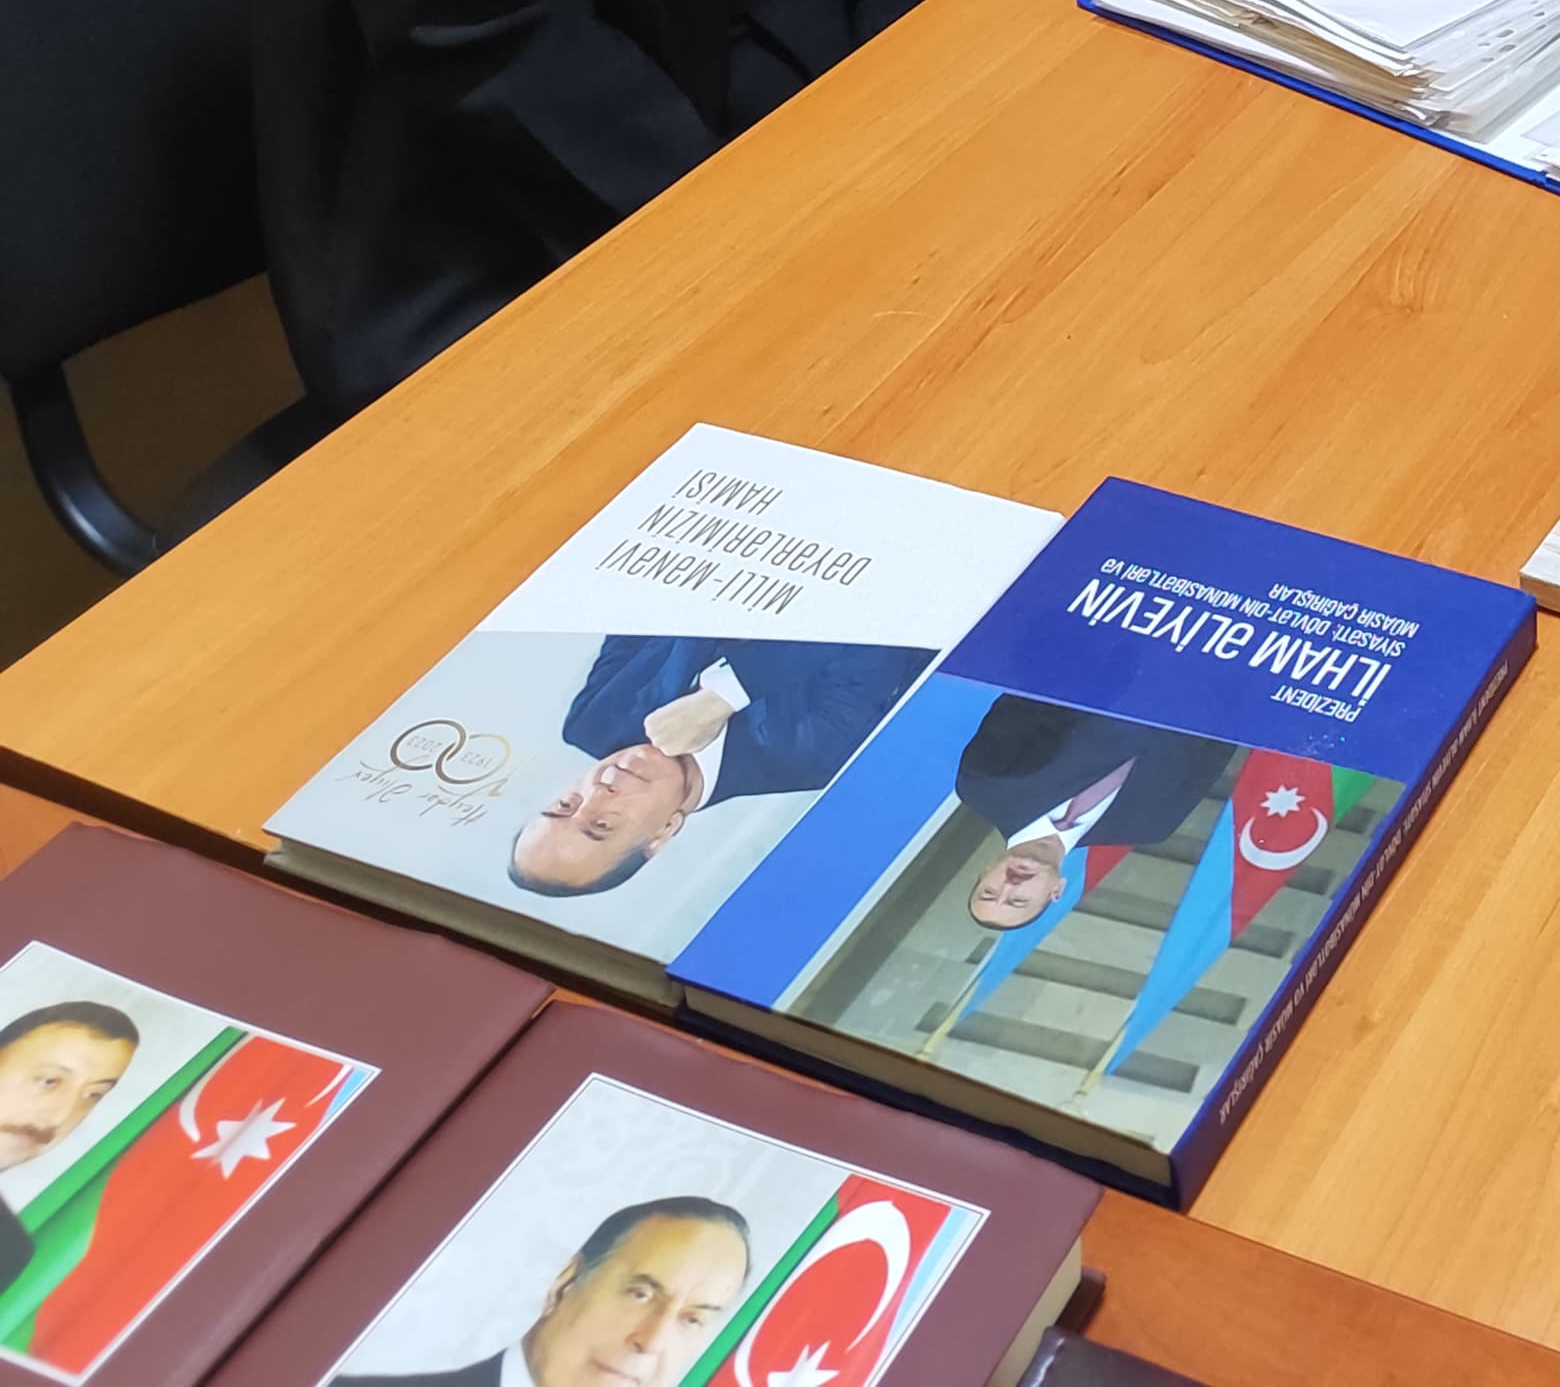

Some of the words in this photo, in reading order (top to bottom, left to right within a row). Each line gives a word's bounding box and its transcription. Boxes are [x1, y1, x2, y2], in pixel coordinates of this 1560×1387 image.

[672, 470, 783, 515] HAMİSİ
[638, 504, 872, 586] DƏYƏRLƏRİMİZİN
[595, 542, 804, 615] MİLLİ-MƏNƏVİ
[1121, 565, 1241, 609] MÜNASİBƏTLƏRİ
[1067, 579, 1254, 659] ƏLİYEVİN
[1239, 598, 1331, 635] DÖVLƏT-DİN
[1358, 610, 1419, 637] MÜASİR
[1249, 631, 1391, 706] İLHAM
[1271, 686, 1361, 721] PREZİDENT
